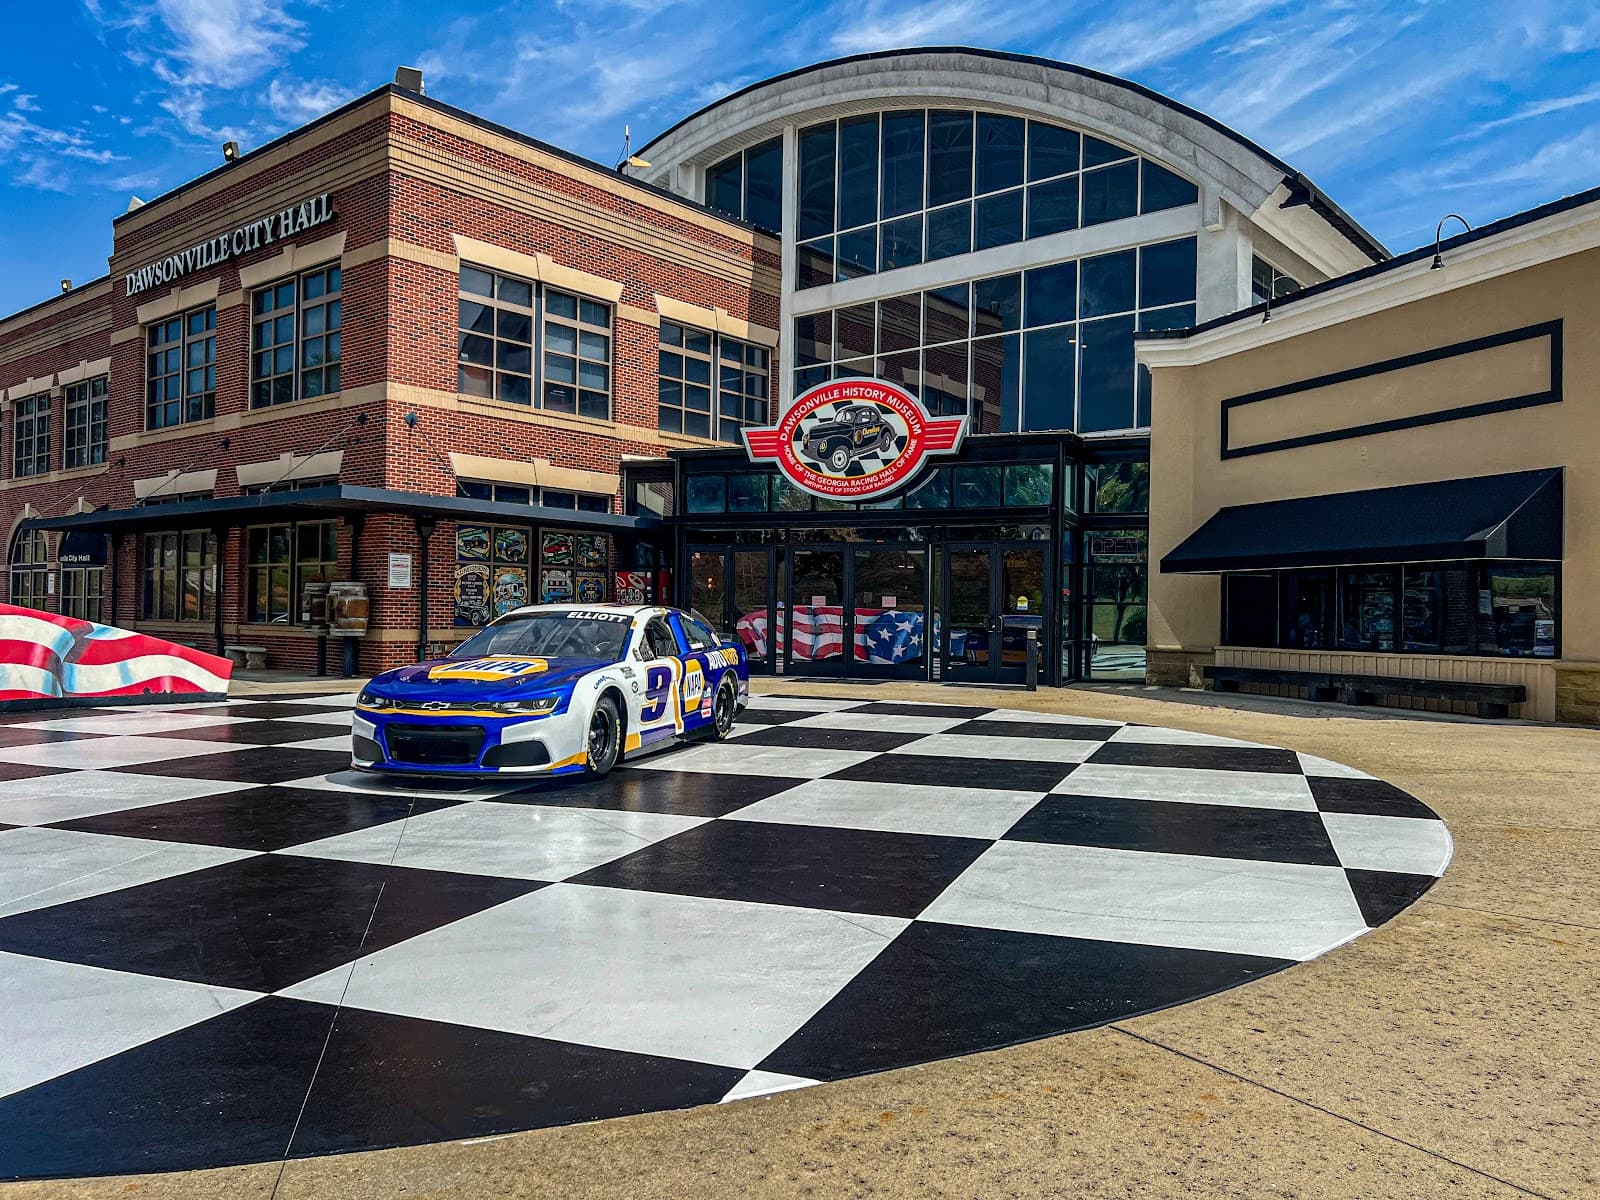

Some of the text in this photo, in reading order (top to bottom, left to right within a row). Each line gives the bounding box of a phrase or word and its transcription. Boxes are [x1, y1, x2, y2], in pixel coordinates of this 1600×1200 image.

[126, 193, 333, 297] DAWSONVILLE CITY HALL
[780, 387, 922, 442] DAWSONVILLE HISTORY MUSEUM
[783, 438, 918, 487] HOME OF THE GEORGIA RACING HALL OF FAME
[804, 478, 834, 493] BIRTHPLACE
[874, 475, 895, 487] RACING
[567, 611, 628, 623] ELLIOTT
[704, 650, 728, 671] AUTO
[640, 664, 672, 725] 9
[686, 671, 702, 699] NAPA
